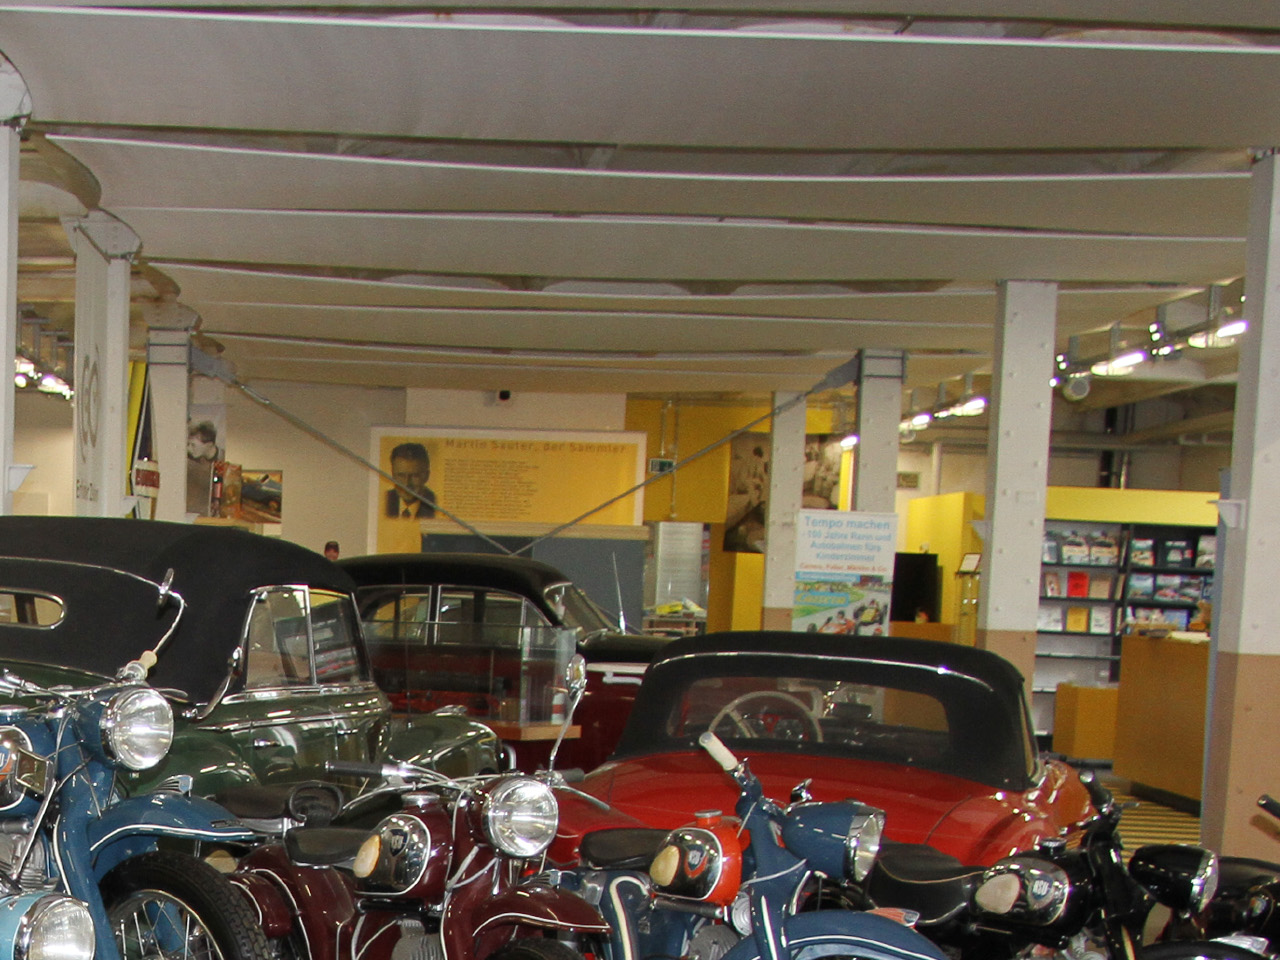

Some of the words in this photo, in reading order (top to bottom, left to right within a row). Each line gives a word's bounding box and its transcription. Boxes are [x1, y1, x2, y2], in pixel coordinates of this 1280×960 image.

[445, 439, 487, 448] Martin
[543, 442, 565, 451] der
[570, 443, 626, 453] Sammler
[805, 515, 843, 529] Tempo
[847, 519, 890, 530] machen
[391, 835, 404, 849] NSU
[688, 850, 701, 865] NSU
[1032, 879, 1050, 896] NSU
